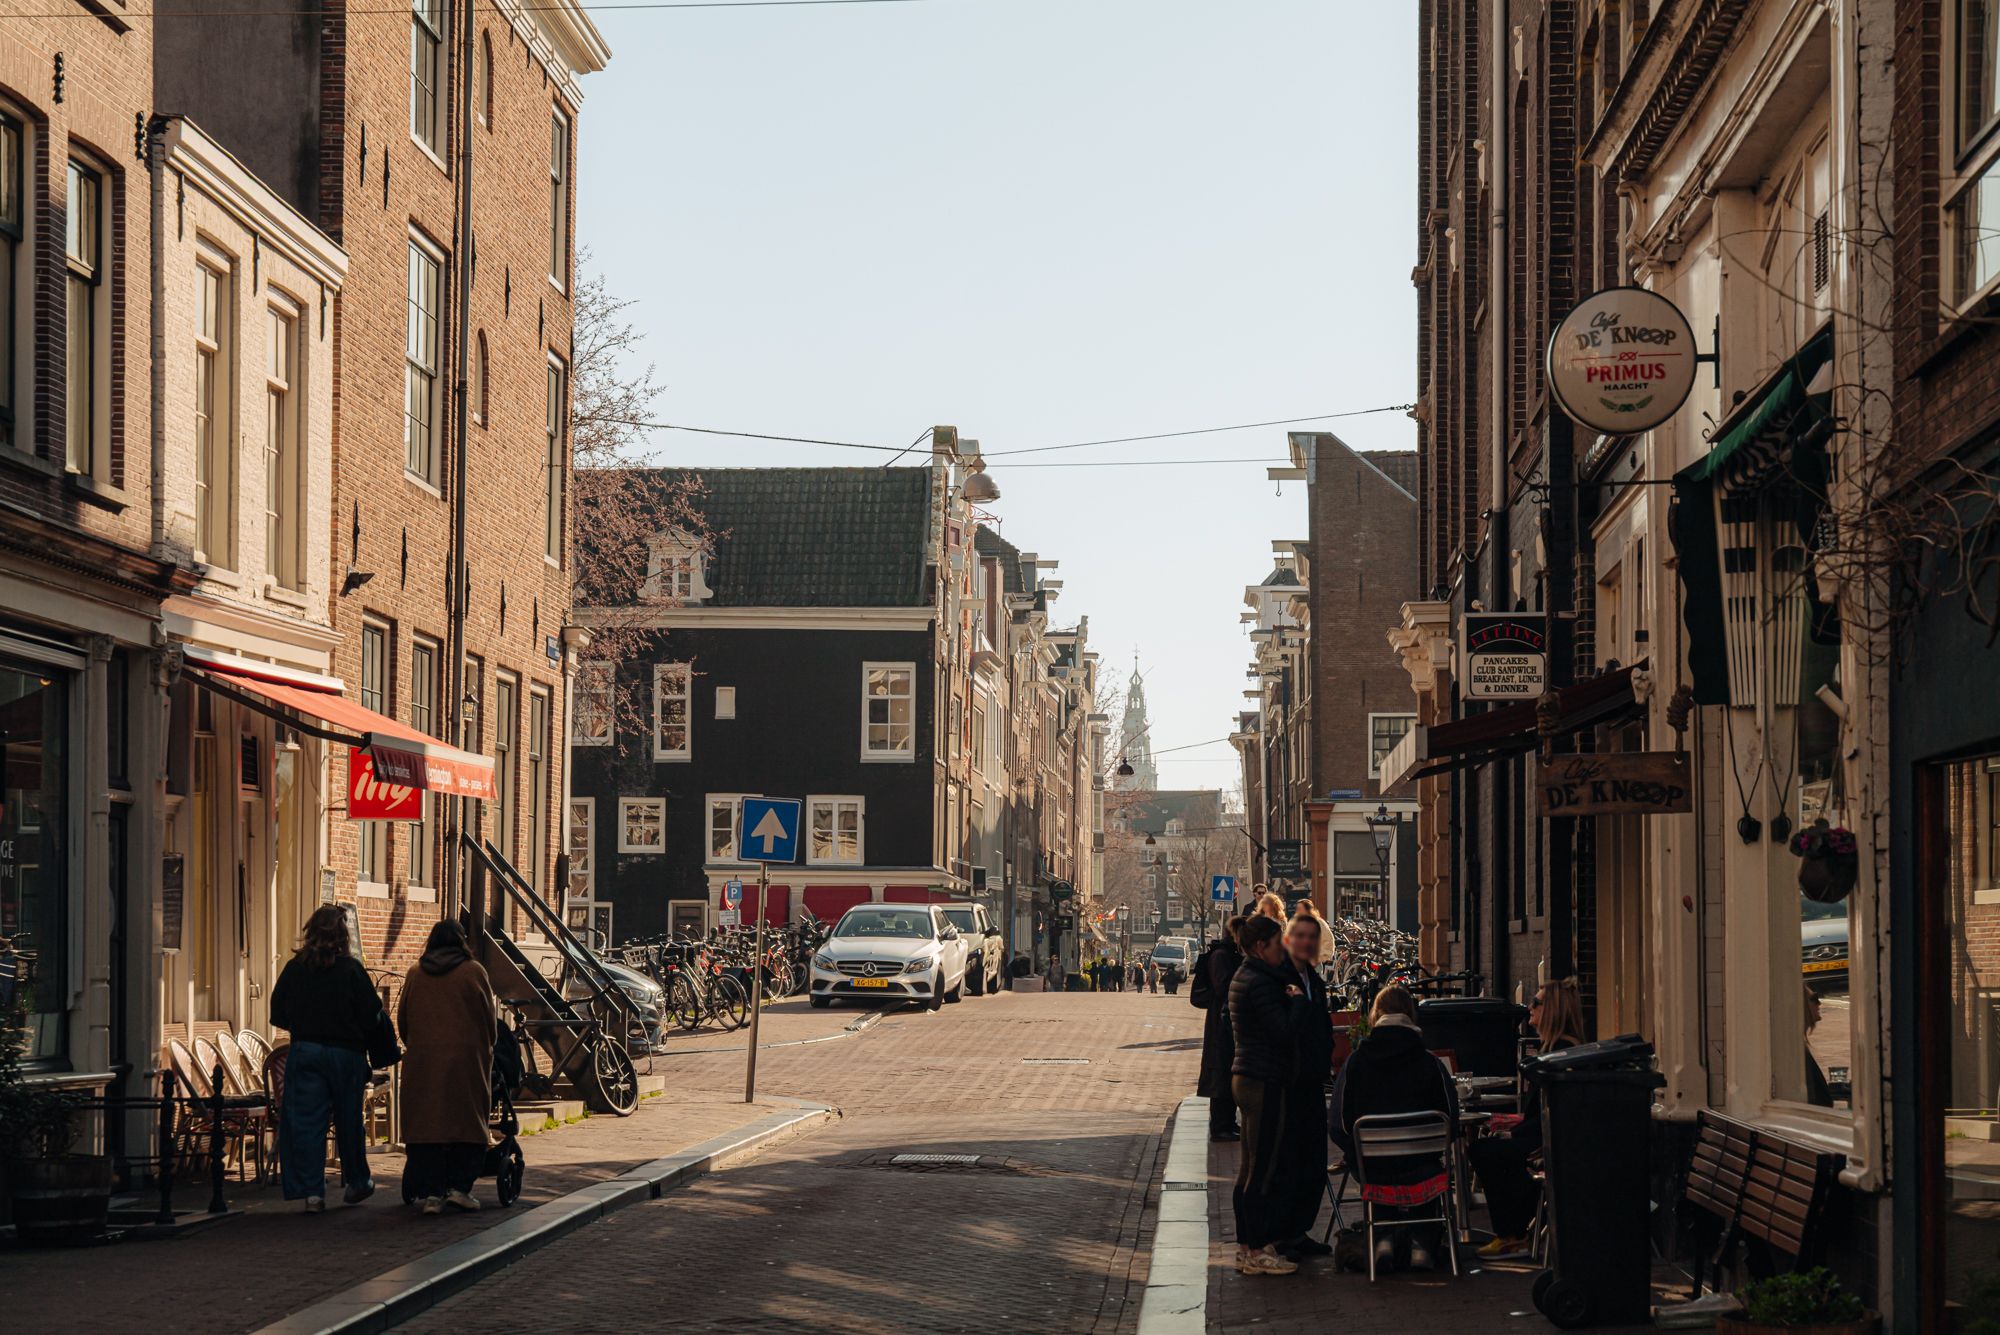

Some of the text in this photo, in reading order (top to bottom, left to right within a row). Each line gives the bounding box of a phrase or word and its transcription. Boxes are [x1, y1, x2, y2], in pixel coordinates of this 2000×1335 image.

[1576, 331, 1602, 350] DE
[1586, 363, 1666, 383] PRIMUS
[1604, 383, 1649, 391] HAACHT
[1471, 626, 1542, 648] LETTING
[1483, 657, 1528, 665] PANCAKES
[1476, 666, 1537, 674] CLUB SANDWICH
[1473, 675, 1542, 684] BREAKFAST, LUNCH
[1484, 685, 1529, 693] & DINNER
[1546, 783, 1579, 808] DE
[731, 887, 738, 898] P
